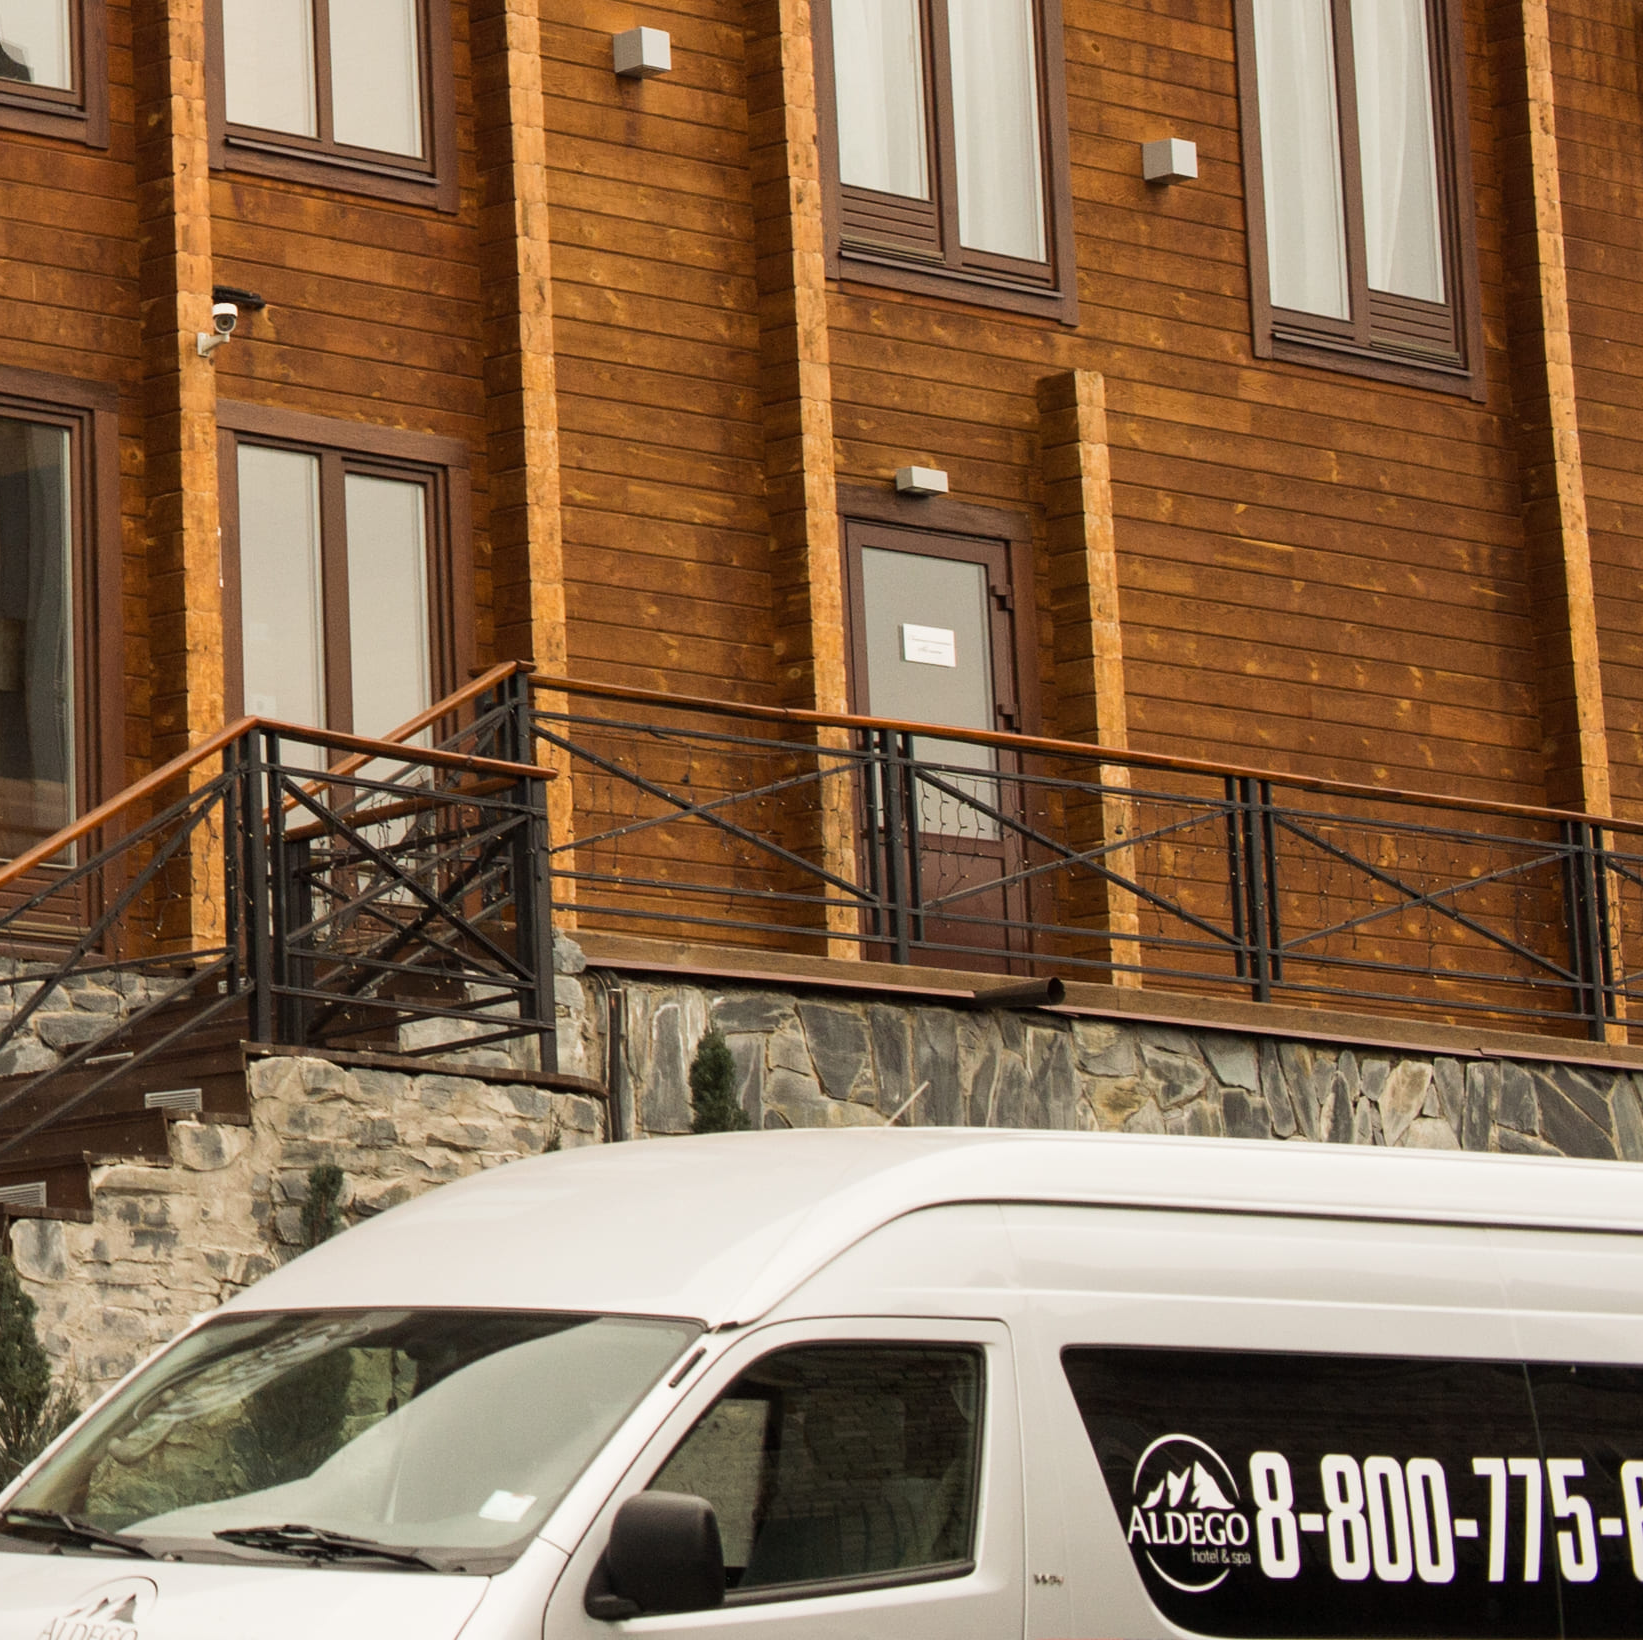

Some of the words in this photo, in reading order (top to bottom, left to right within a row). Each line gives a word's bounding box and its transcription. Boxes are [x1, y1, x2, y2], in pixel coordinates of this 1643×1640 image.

[1127, 1505, 1250, 1546] ALDEGO
[1192, 1547, 1218, 1564] hotel
[1231, 1552, 1252, 1567] spa
